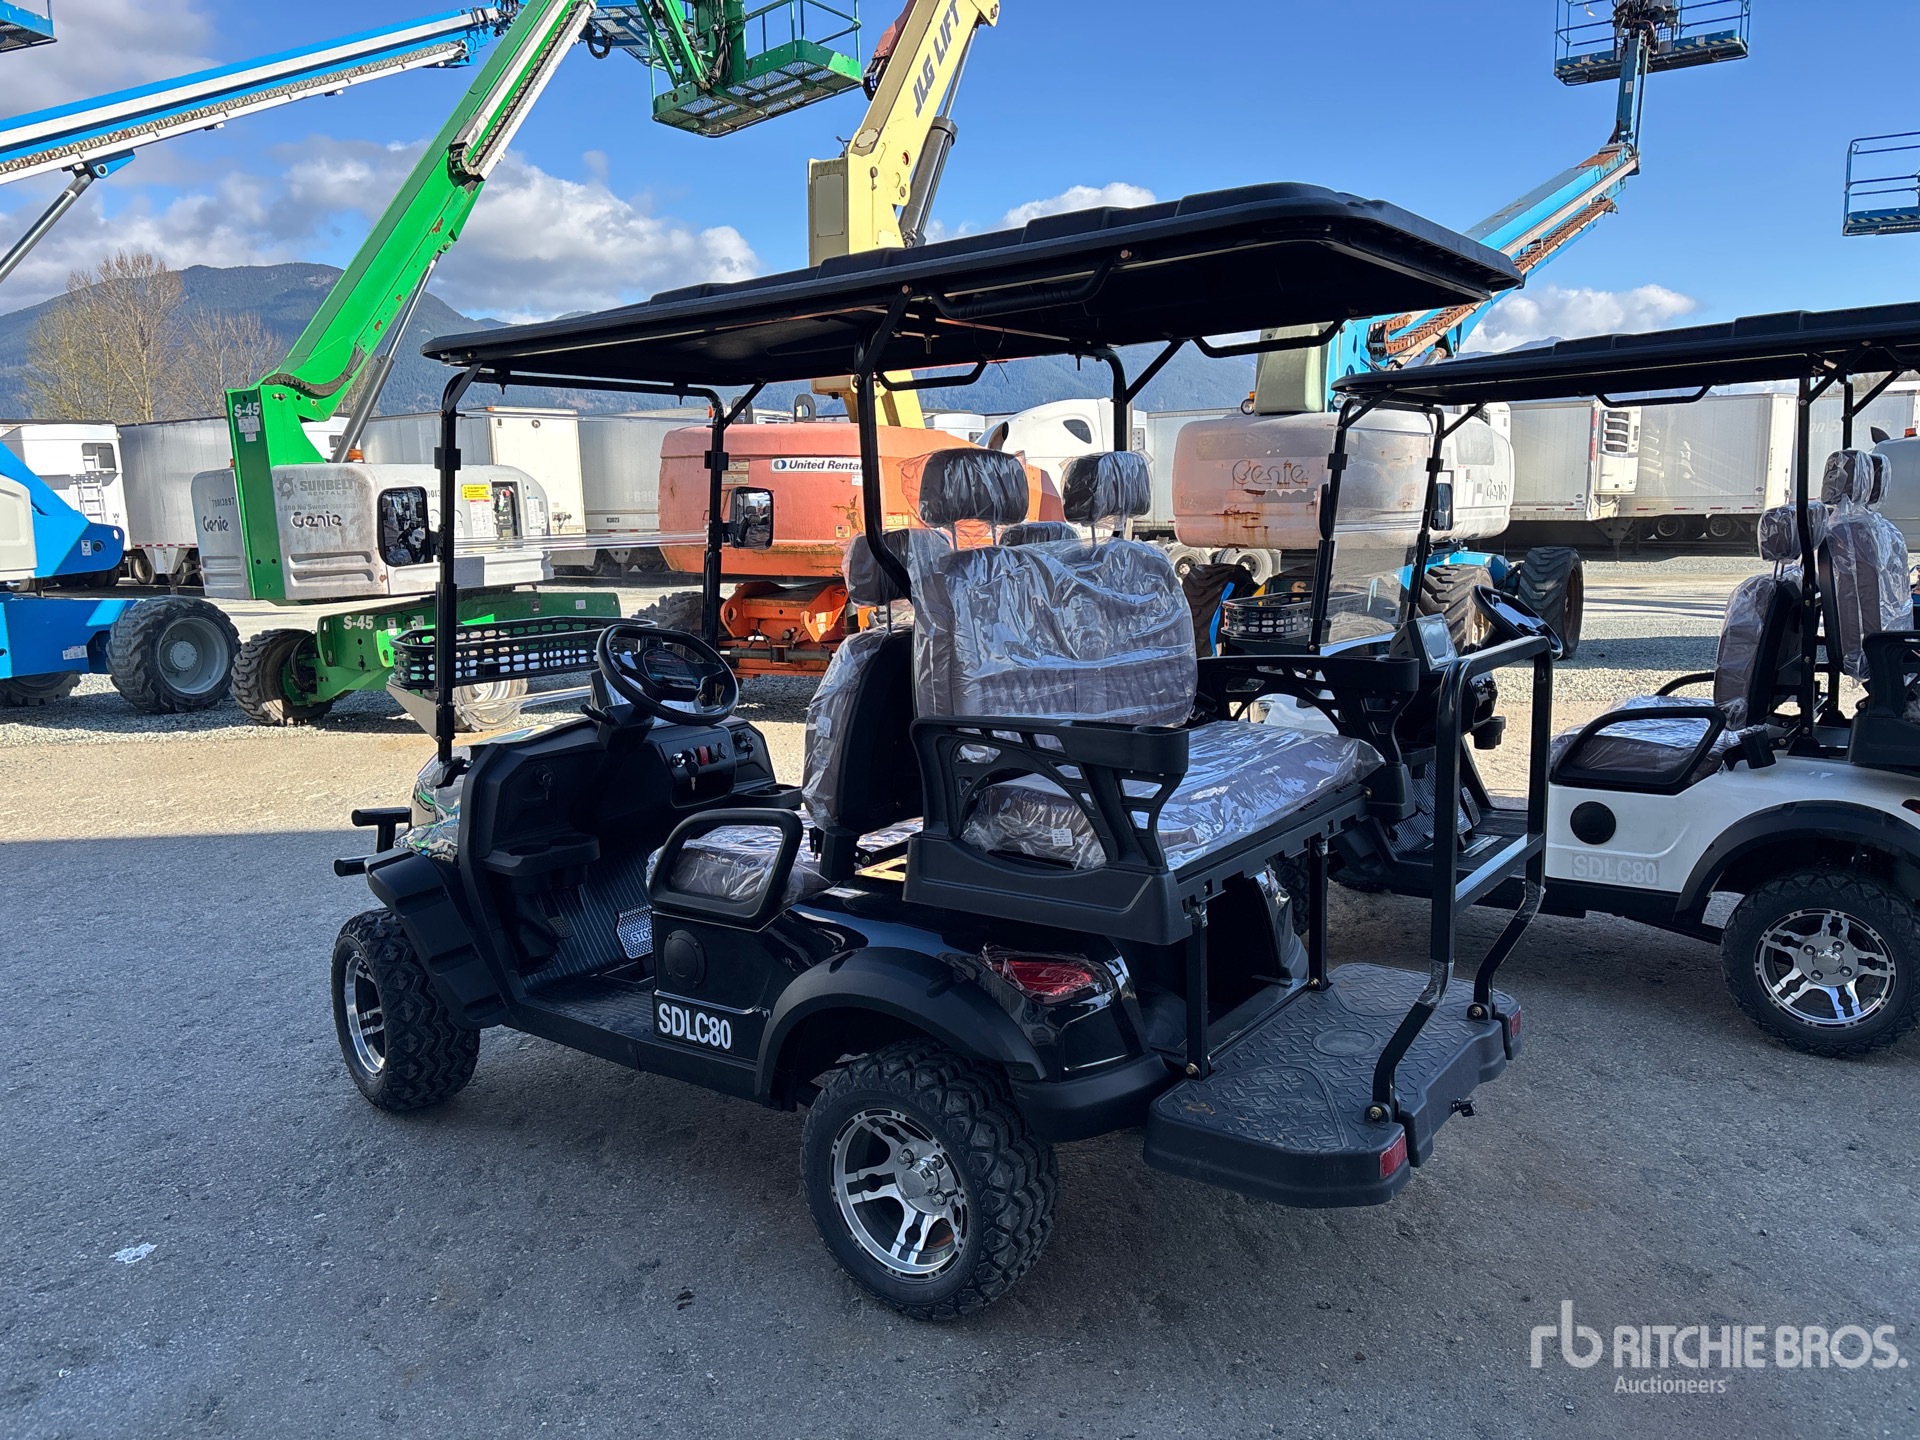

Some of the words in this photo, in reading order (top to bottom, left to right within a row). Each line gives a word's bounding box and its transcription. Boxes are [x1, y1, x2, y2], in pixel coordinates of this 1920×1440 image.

[913, 53, 936, 118] JLG
[933, 0, 960, 67] LIFT
[233, 402, 260, 417] S-45
[789, 460, 825, 470] United
[1231, 459, 1309, 485] Genie
[299, 478, 355, 492] SUNBELT
[308, 503, 329, 511] Sweat
[202, 515, 230, 533] Genie
[290, 510, 343, 529] Genie
[343, 615, 374, 630] S-45
[1573, 854, 1658, 885] SDLC80
[658, 1003, 732, 1050] SDLC80
